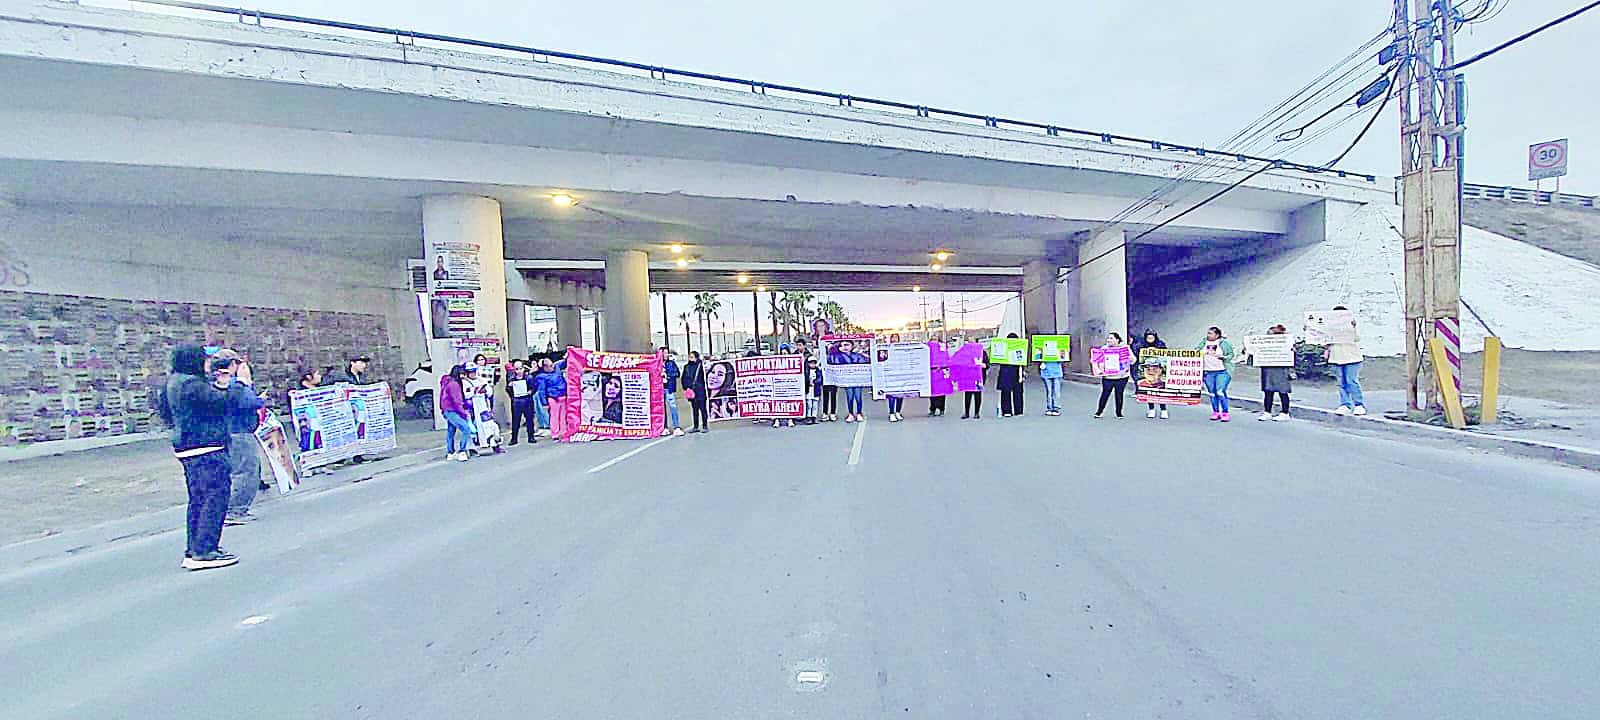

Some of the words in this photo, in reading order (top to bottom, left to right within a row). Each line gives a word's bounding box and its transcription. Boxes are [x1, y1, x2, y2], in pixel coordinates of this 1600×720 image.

[1540, 149, 1557, 160] 30
[1143, 349, 1200, 358] DESAPARECIDO
[586, 353, 600, 368] SE
[738, 358, 800, 371] IMPORTANTE
